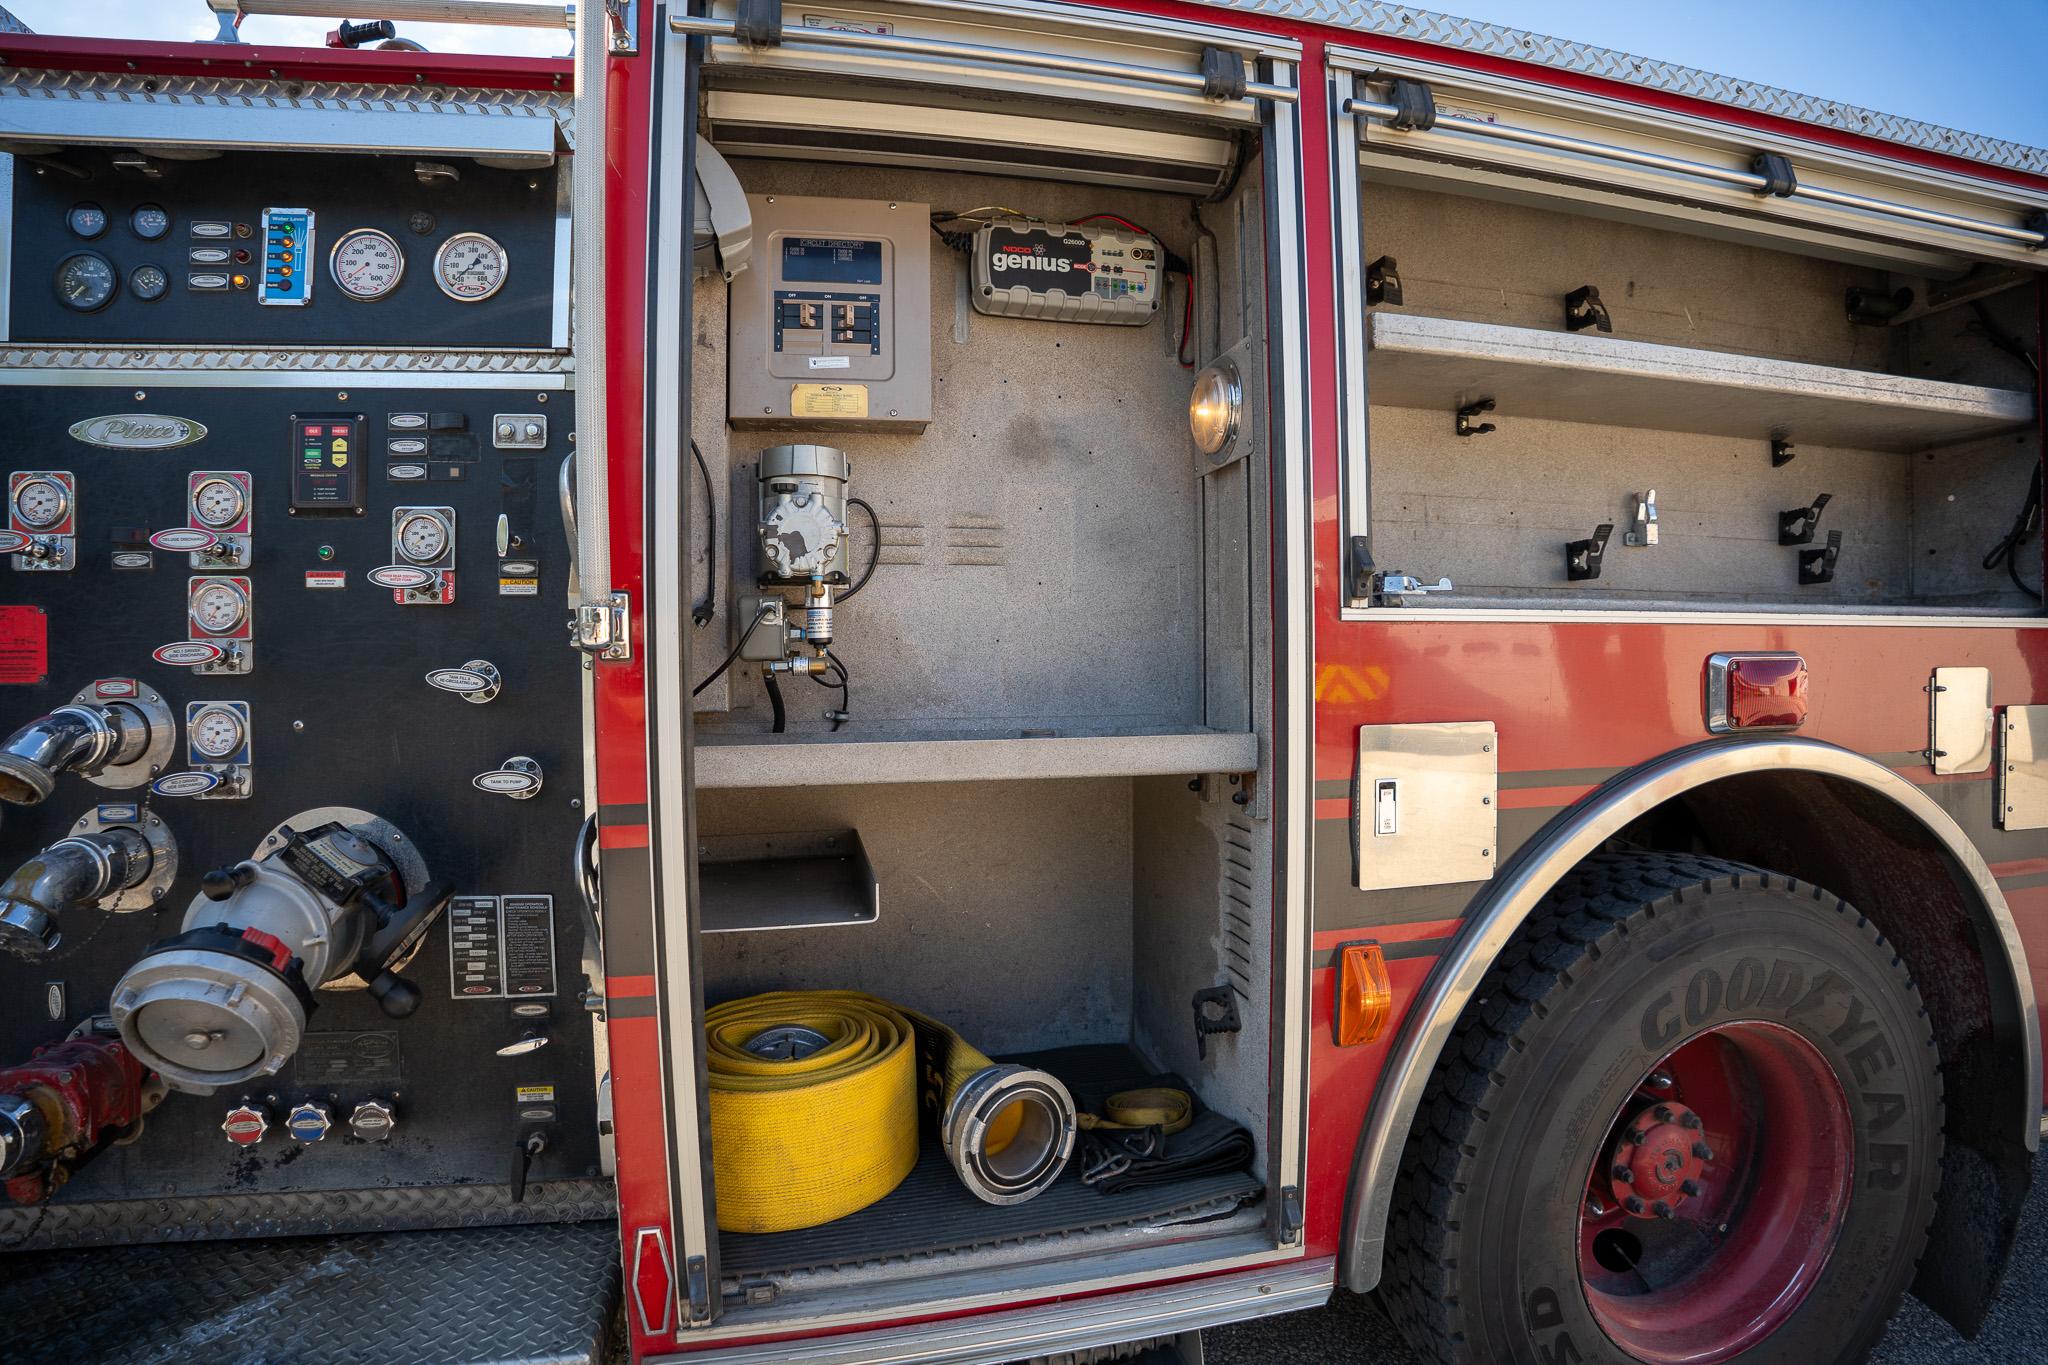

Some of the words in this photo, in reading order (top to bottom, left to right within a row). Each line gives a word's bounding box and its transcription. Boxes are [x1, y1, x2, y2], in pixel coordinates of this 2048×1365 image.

[992, 252, 1070, 272] genius
[102, 420, 175, 440] Pierce
[1640, 957, 1909, 1190] GOODYEAR
